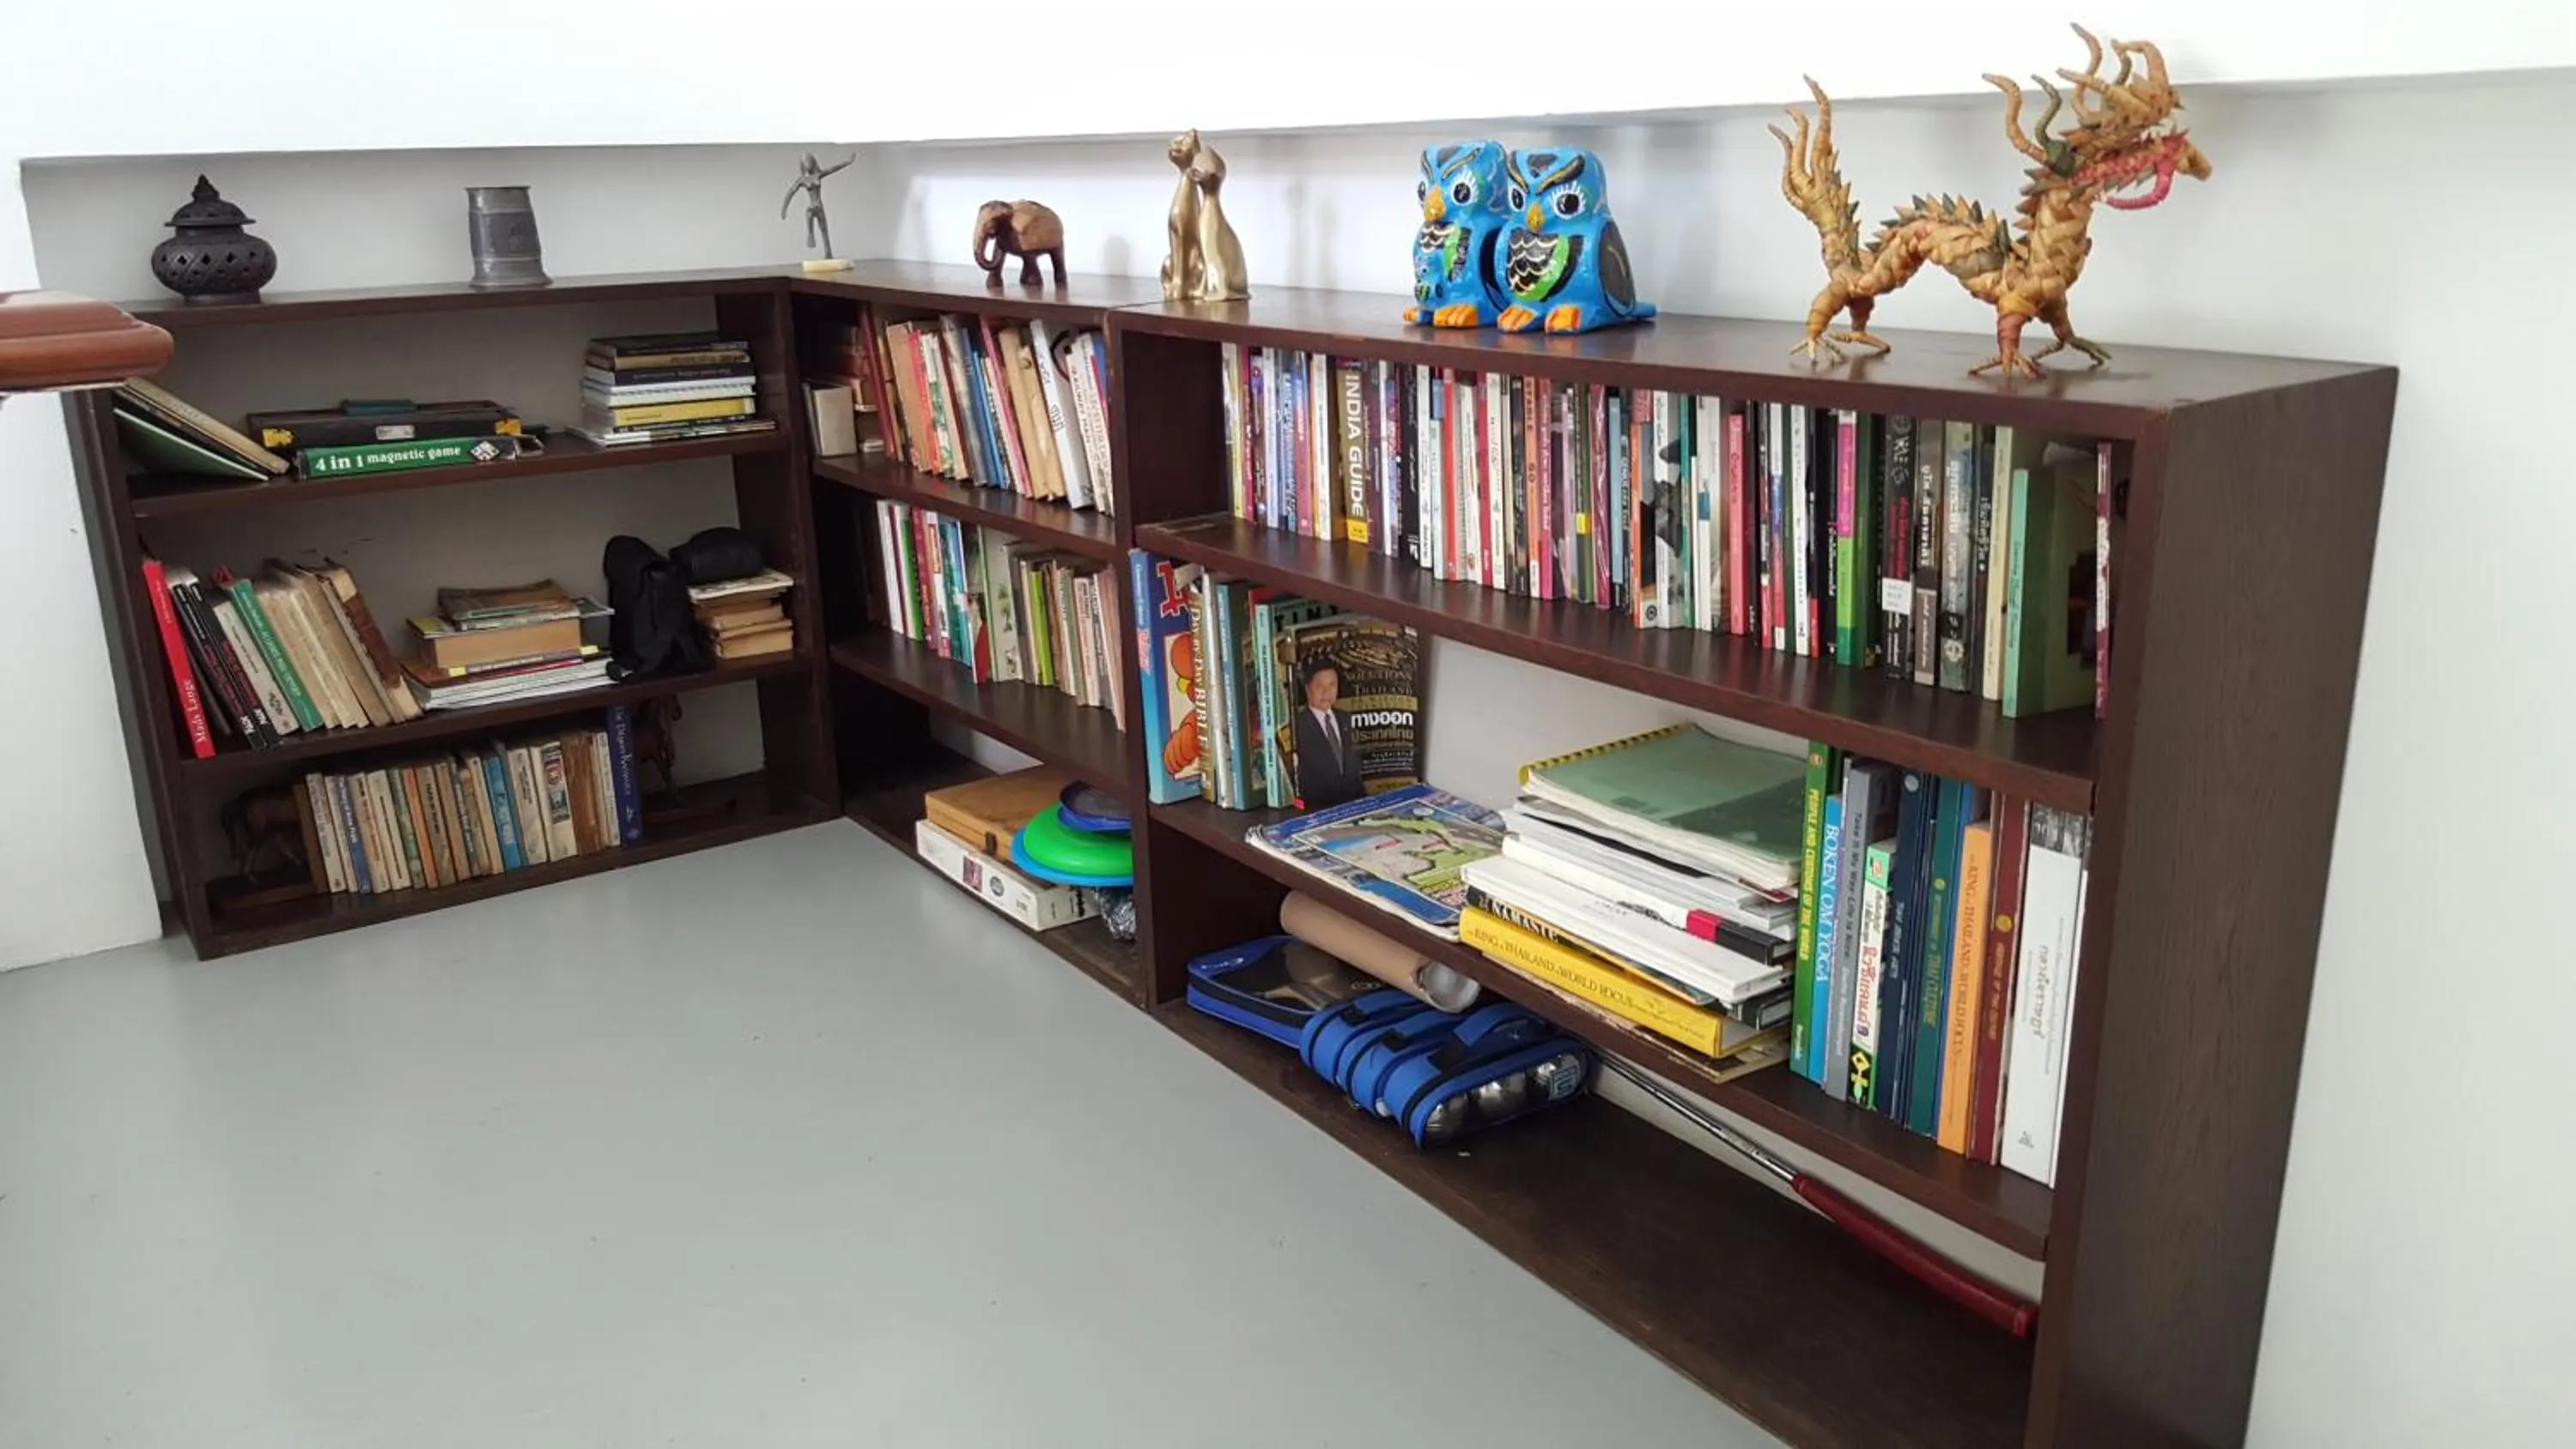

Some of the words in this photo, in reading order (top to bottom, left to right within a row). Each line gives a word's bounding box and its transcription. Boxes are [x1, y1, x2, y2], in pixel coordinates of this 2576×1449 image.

[1344, 374, 1363, 440] INDIA
[315, 457, 326, 471] 4
[330, 455, 352, 470] in
[355, 455, 364, 468] 1
[367, 448, 425, 464] magnetic
[428, 446, 461, 460] game
[1349, 446, 1364, 516] GUIDE
[1807, 788, 1820, 825] PEOPLE
[1806, 827, 1819, 847] AND
[1802, 848, 1816, 894] CUSTOMS
[1821, 824, 1840, 890] BOKEN
[1820, 894, 1835, 926] OM
[1504, 942, 1555, 972] THAILAND
[1799, 927, 1811, 961] WORLD
[1816, 933, 1832, 981] YOGA
